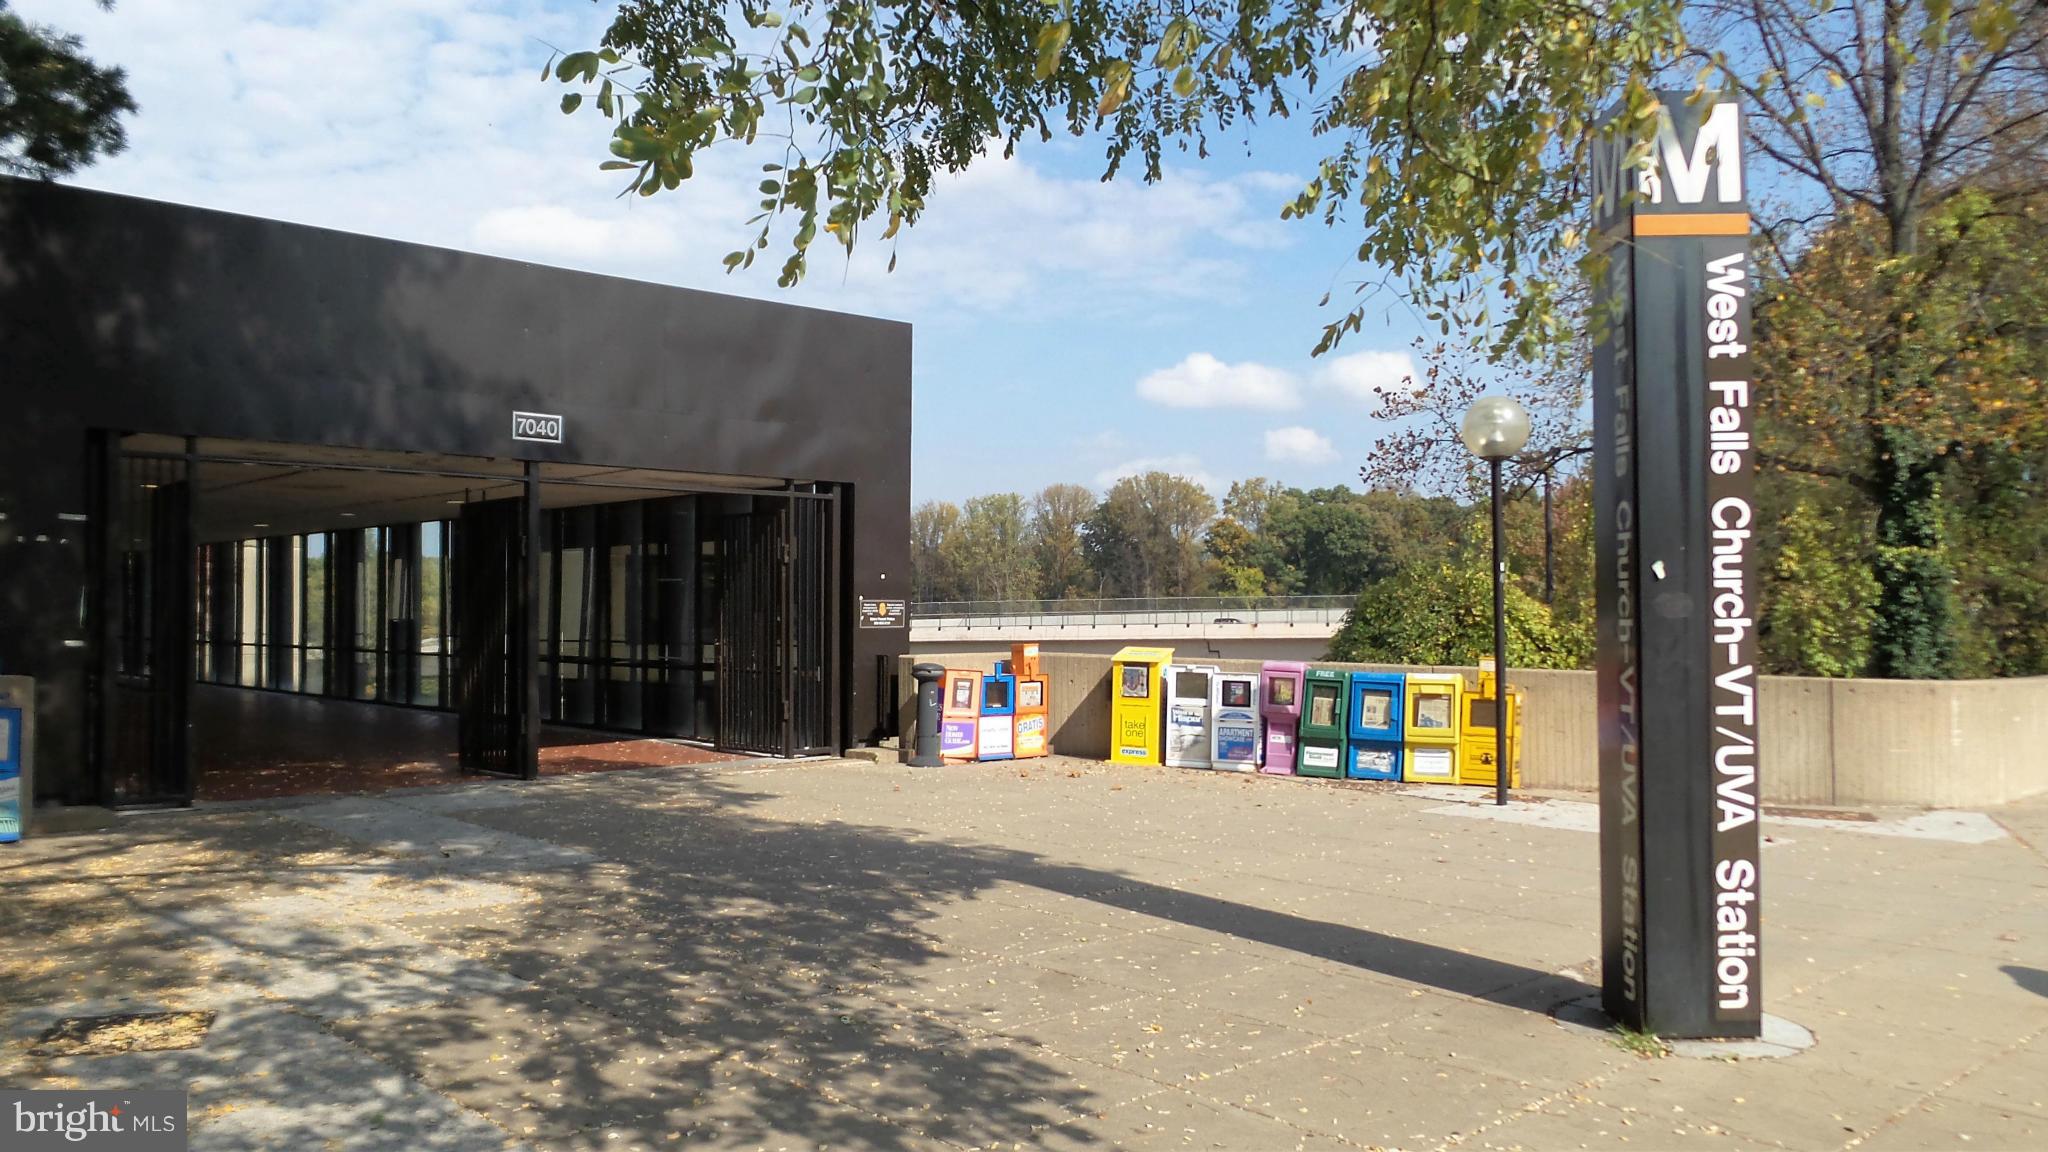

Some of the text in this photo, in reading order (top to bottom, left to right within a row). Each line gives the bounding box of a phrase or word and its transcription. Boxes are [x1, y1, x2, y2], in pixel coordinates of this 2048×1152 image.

[1637, 103, 1742, 204] M
[517, 418, 558, 437] 7040
[1706, 252, 1757, 1010] West Falls Church-VT/UVA Station
[1315, 670, 1335, 678] FREE
[1018, 718, 1043, 734] GRATIS
[1124, 720, 1146, 730] take
[1125, 729, 1144, 738] one
[1121, 747, 1147, 756] express
[1621, 855, 1640, 1002] Station
